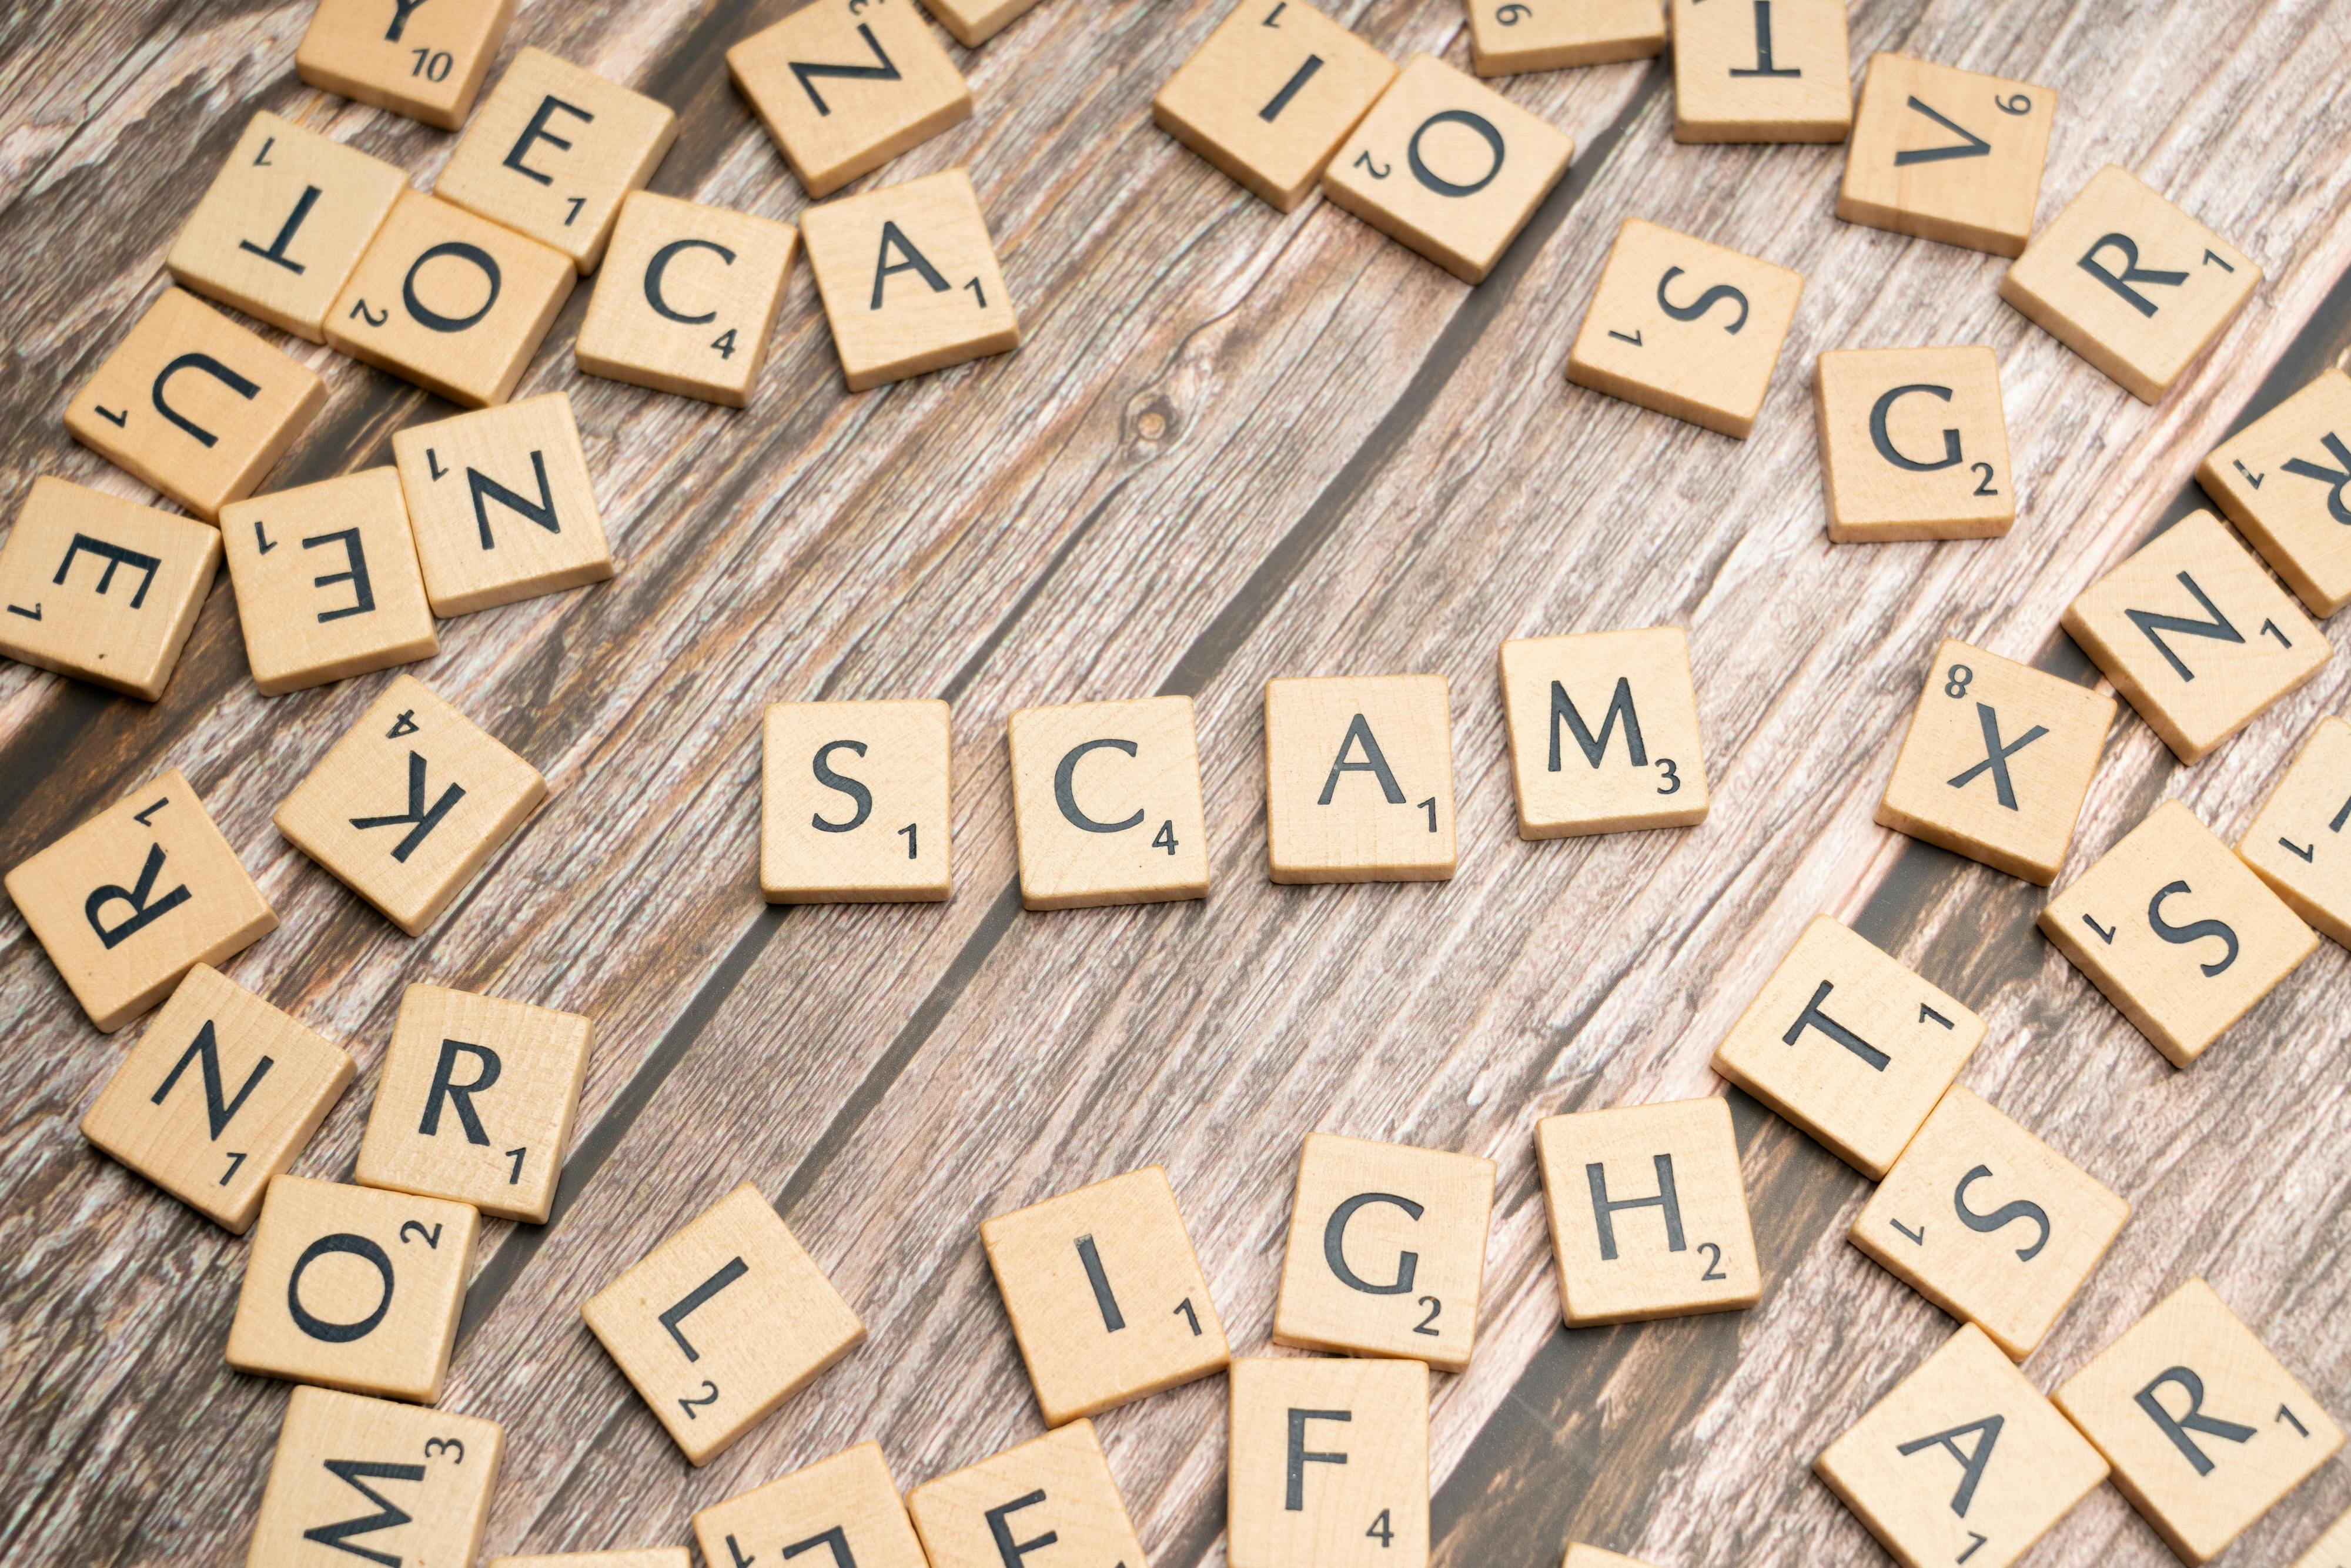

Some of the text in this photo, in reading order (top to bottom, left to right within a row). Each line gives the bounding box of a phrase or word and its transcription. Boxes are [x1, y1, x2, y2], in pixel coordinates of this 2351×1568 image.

[412, 48, 453, 82] 10
[503, 95, 594, 186] E
[1895, 96, 1991, 166] V
[253, 137, 275, 166] 1
[1355, 151, 1390, 179] 2
[1408, 110, 1504, 197] O
[239, 185, 322, 275] T
[564, 198, 586, 226] 1
[871, 221, 951, 310] A
[2078, 233, 2189, 317] R
[2204, 250, 2233, 272] 1
[402, 242, 501, 333] O
[644, 239, 735, 325] C
[964, 277, 986, 307] 1
[1658, 266, 1748, 334] S
[350, 299, 388, 327] 2
[711, 329, 736, 359] 4
[1609, 331, 1642, 346] 1
[94, 405, 128, 428] 1
[152, 352, 261, 448] U
[1870, 384, 1962, 472] G
[426, 449, 448, 481] 1
[1971, 462, 1998, 496] 2
[2234, 460, 2264, 489] 1
[466, 450, 560, 550] N
[255, 521, 277, 555] 1
[52, 533, 162, 609] E
[302, 527, 376, 623] E
[7, 603, 42, 621] 1
[2125, 571, 2245, 681] N
[2261, 618, 2292, 648] 1
[1945, 664, 1972, 698] 8
[386, 710, 419, 739] 4
[812, 677, 1648, 833] S C A M
[1948, 703, 2049, 811] X
[1656, 758, 1680, 794] 3
[133, 797, 169, 827] 1
[349, 750, 466, 863] K
[1418, 797, 1437, 832] 1
[898, 823, 917, 859] 1
[1152, 820, 1178, 855] 4
[2279, 837, 2313, 862] 1
[85, 842, 192, 950] R
[2083, 914, 2116, 944] 1
[2148, 880, 2239, 977] S
[1783, 980, 1891, 1071] T
[1919, 1004, 1954, 1029] 1
[151, 1019, 274, 1142] N
[419, 1039, 501, 1146] R
[219, 1152, 247, 1186] 1
[506, 1147, 526, 1185] 1
[1586, 1154, 1686, 1259] H
[1955, 1165, 2050, 1261] S
[400, 1221, 442, 1249] 2
[1325, 1192, 1424, 1295] G
[1891, 1219, 1924, 1245] 1
[1698, 1243, 1725, 1281] 2
[287, 1233, 394, 1343] O
[658, 1256, 748, 1362] L
[1173, 1298, 1202, 1336] 1
[1413, 1296, 1441, 1336] 2
[678, 1380, 718, 1419] 2
[2134, 1366, 2257, 1476] R
[2276, 1405, 2309, 1437] 1
[424, 1437, 464, 1464] 3
[1286, 1408, 1352, 1511] F
[1898, 1415, 2004, 1517] A
[303, 1459, 426, 1568] M
[1366, 1510, 1394, 1547] 4
[1957, 1533, 1987, 1564] 1
